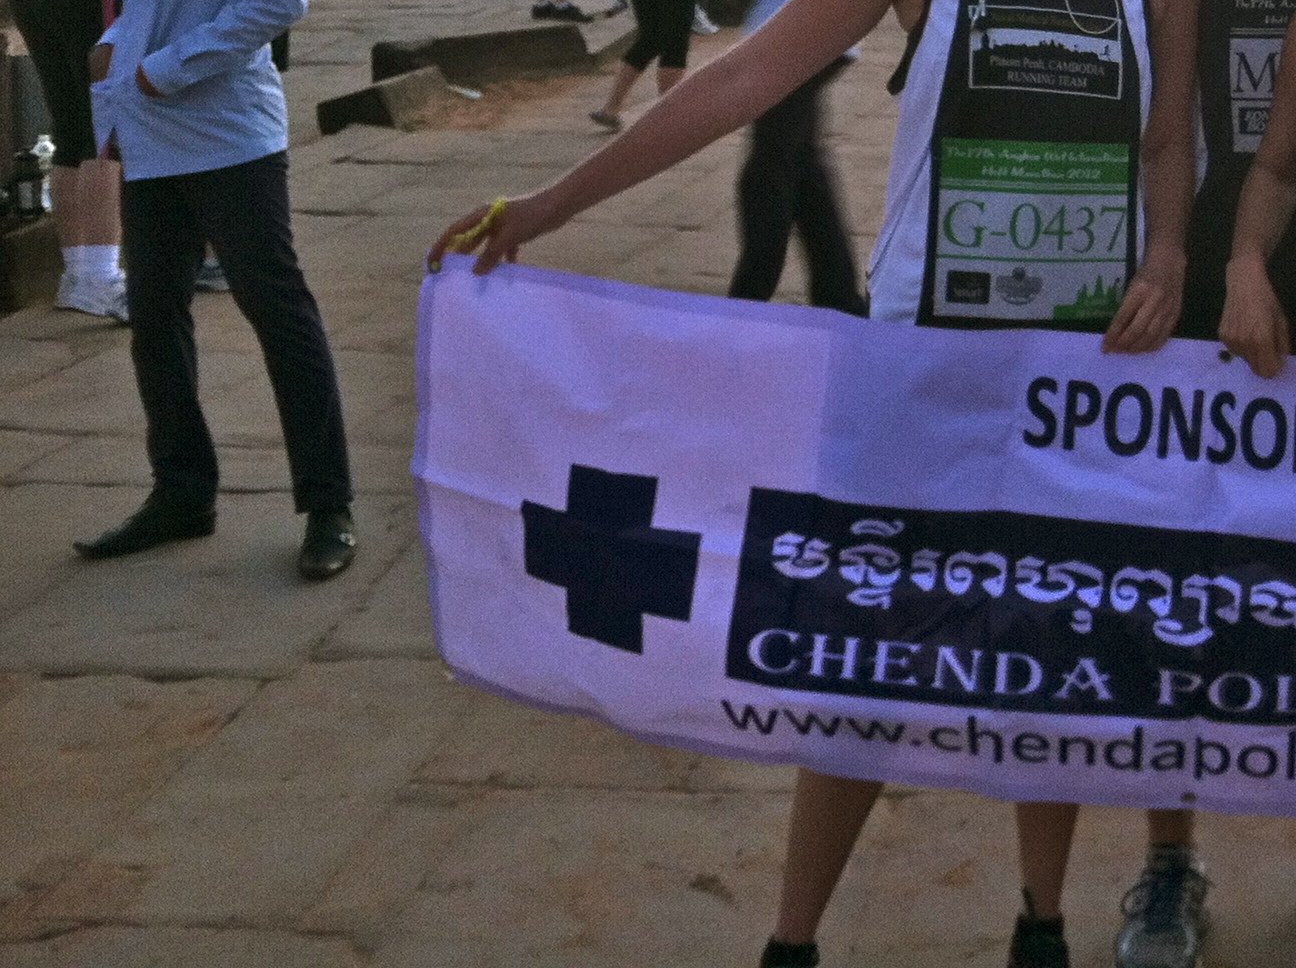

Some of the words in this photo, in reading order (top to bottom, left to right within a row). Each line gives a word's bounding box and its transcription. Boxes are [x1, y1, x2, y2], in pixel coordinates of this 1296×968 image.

[1007, 70, 1056, 85] RUNNING
[1058, 75, 1088, 88] TEAM
[1048, 60, 1106, 76] CAMBODIA
[942, 198, 1127, 254] G-0437
[747, 628, 1114, 702] CHENDA
